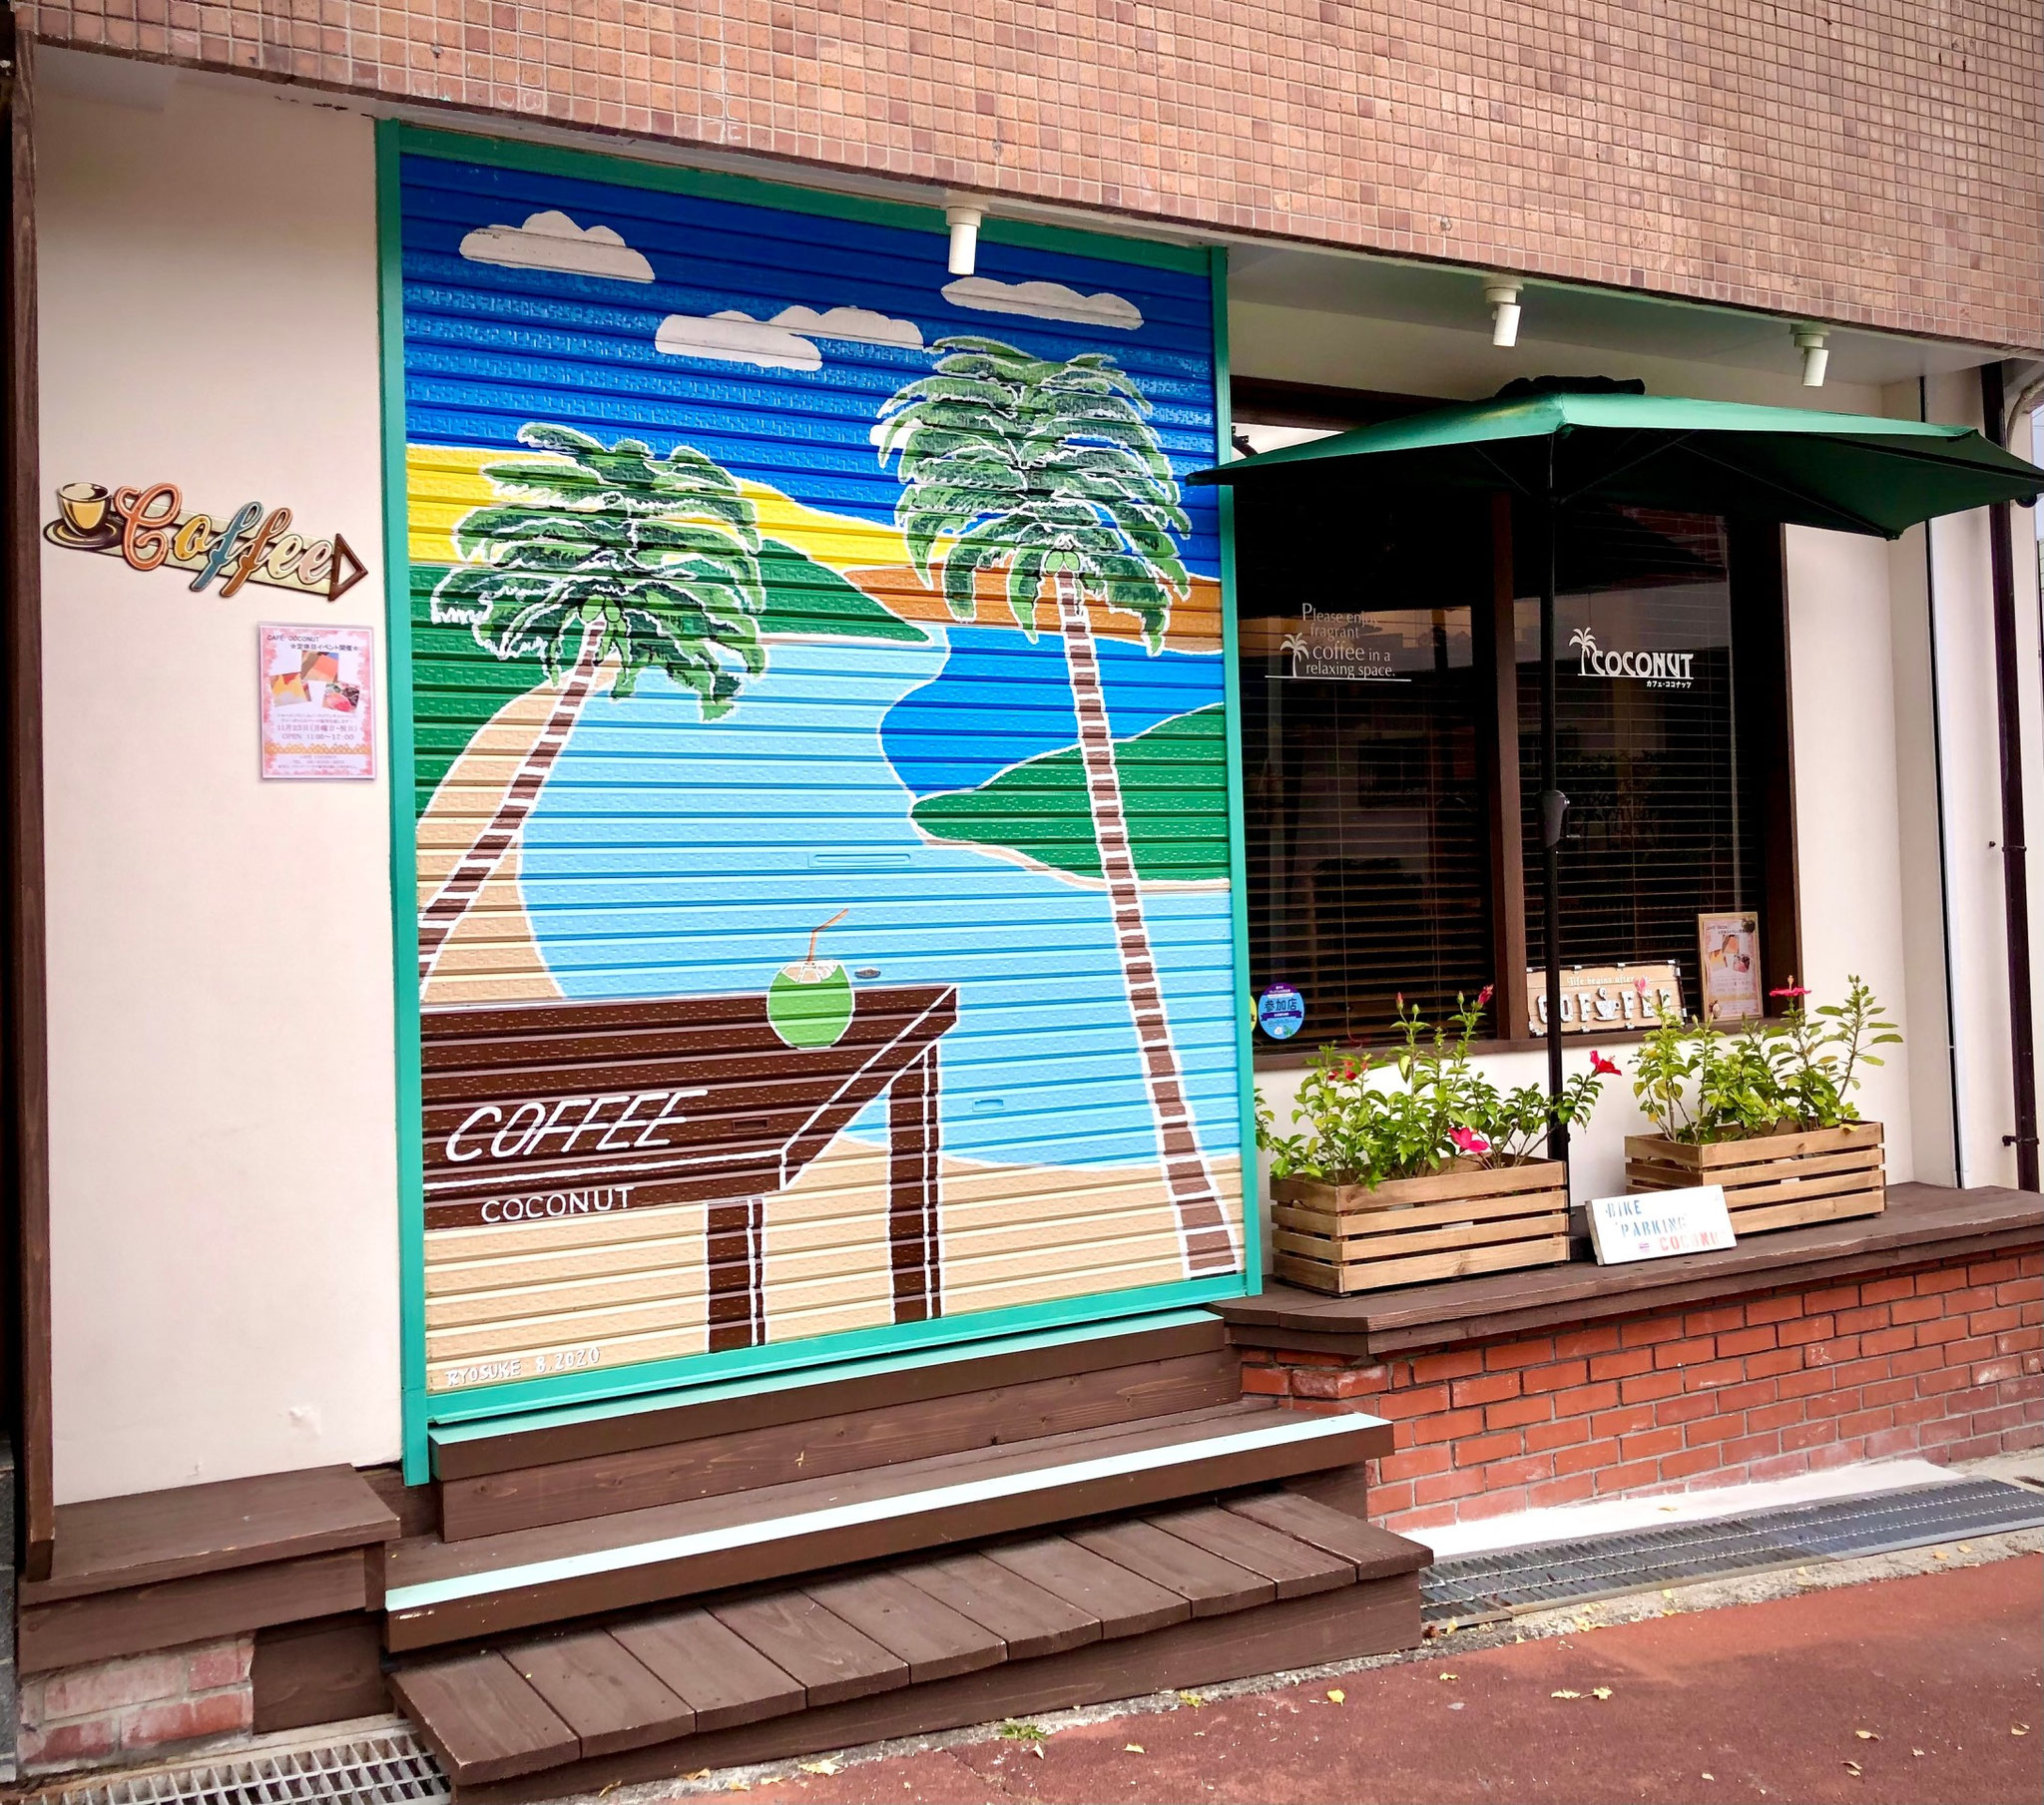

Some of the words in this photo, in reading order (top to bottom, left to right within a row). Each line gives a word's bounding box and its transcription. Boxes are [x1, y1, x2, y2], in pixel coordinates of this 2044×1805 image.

[113, 482, 334, 598] Coffee
[1301, 603, 1343, 624] Please
[1346, 611, 1379, 630] enjoy
[1309, 622, 1359, 642] fragrant
[1312, 640, 1365, 662] coffee
[1368, 649, 1380, 662] in
[1384, 652, 1391, 663] a
[1591, 651, 1695, 679] COCONUT
[1305, 662, 1355, 679] relaxing
[1358, 666, 1396, 679] space.
[1264, 998, 1297, 1013] 参加店
[445, 1089, 709, 1162] COFFEE
[480, 1185, 636, 1223] COCONUT
[1606, 1199, 1643, 1218] BIKE
[445, 1360, 522, 1388] RYOSUKE
[534, 1347, 601, 1373] 8.2020
